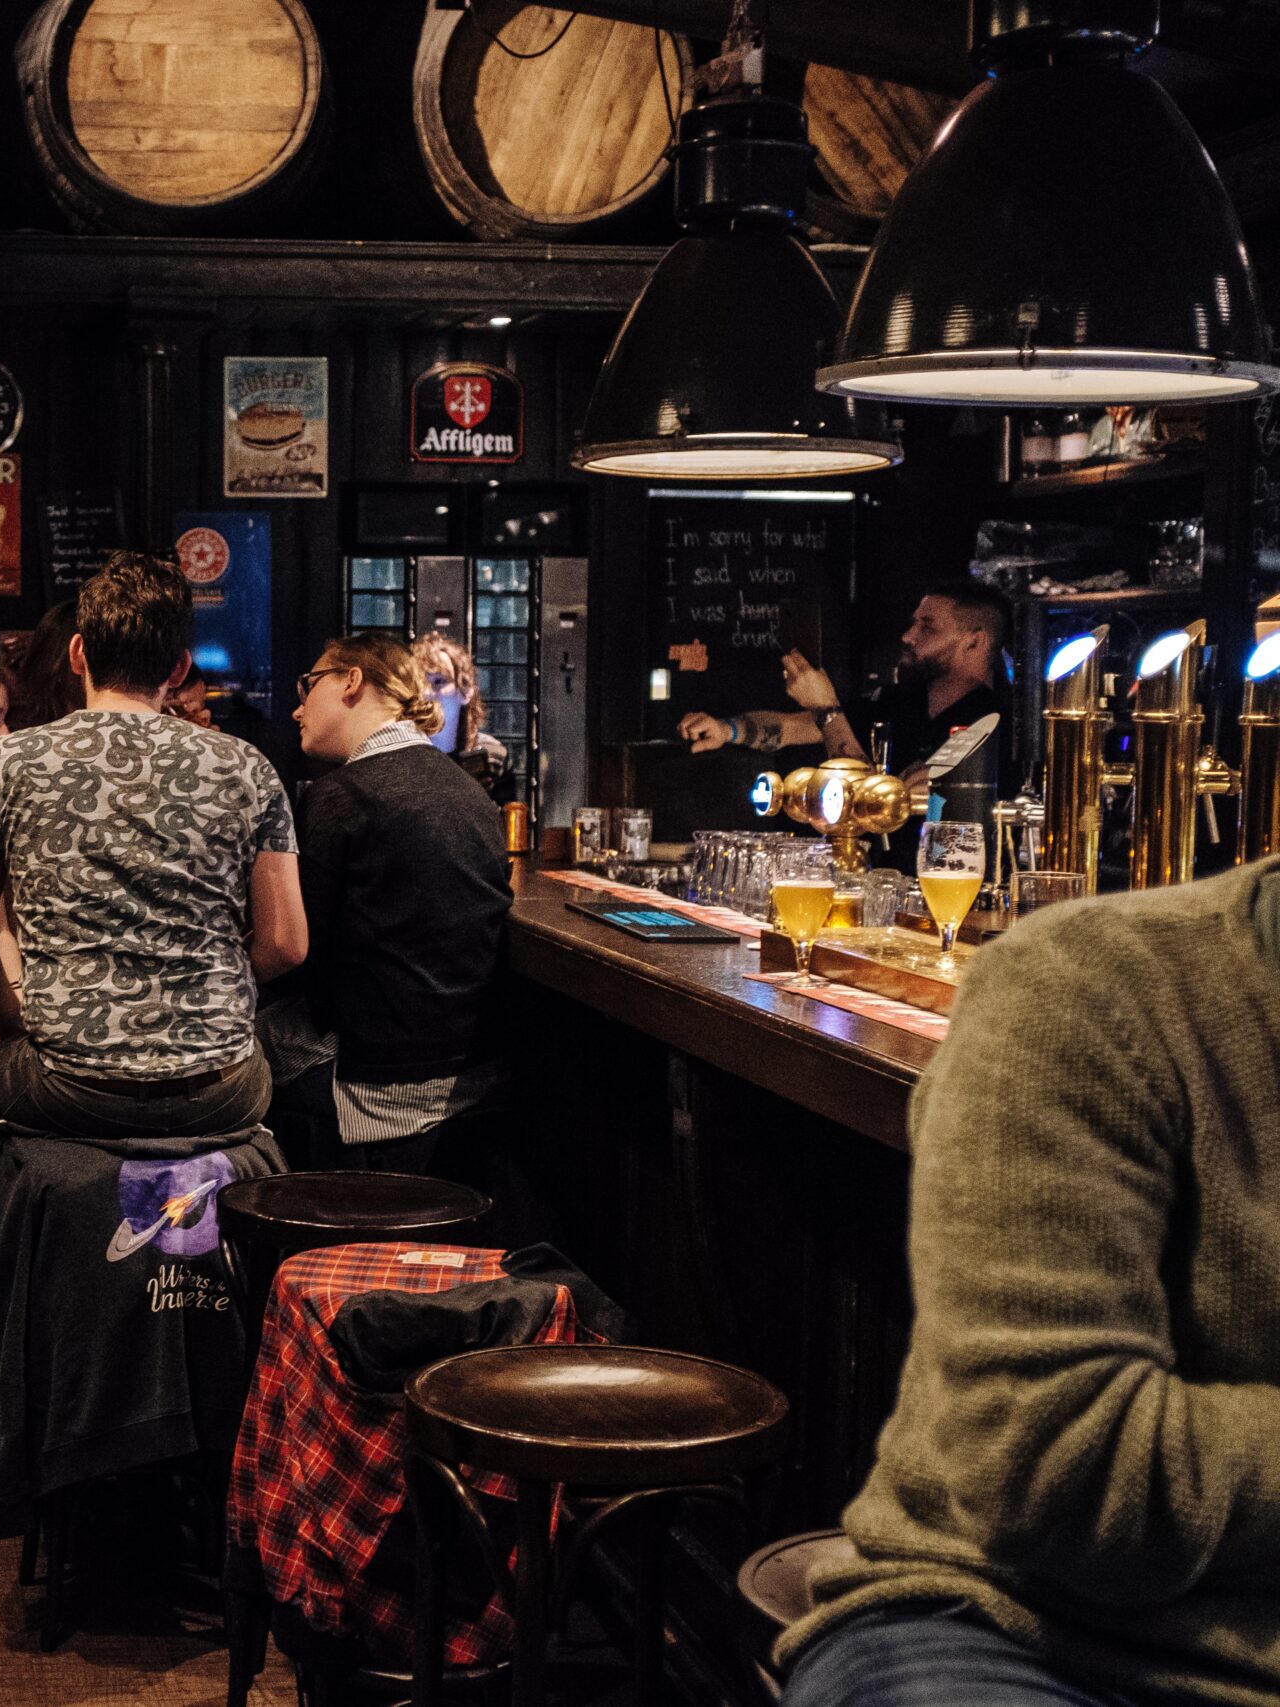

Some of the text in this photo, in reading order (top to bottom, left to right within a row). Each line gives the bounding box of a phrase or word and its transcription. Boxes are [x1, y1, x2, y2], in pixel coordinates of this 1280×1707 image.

[420, 426, 515, 456] Affligem
[708, 530, 752, 556] sorry
[762, 517, 785, 547] for
[792, 518, 827, 550] what
[665, 552, 797, 586] I said when
[690, 604, 727, 623] was
